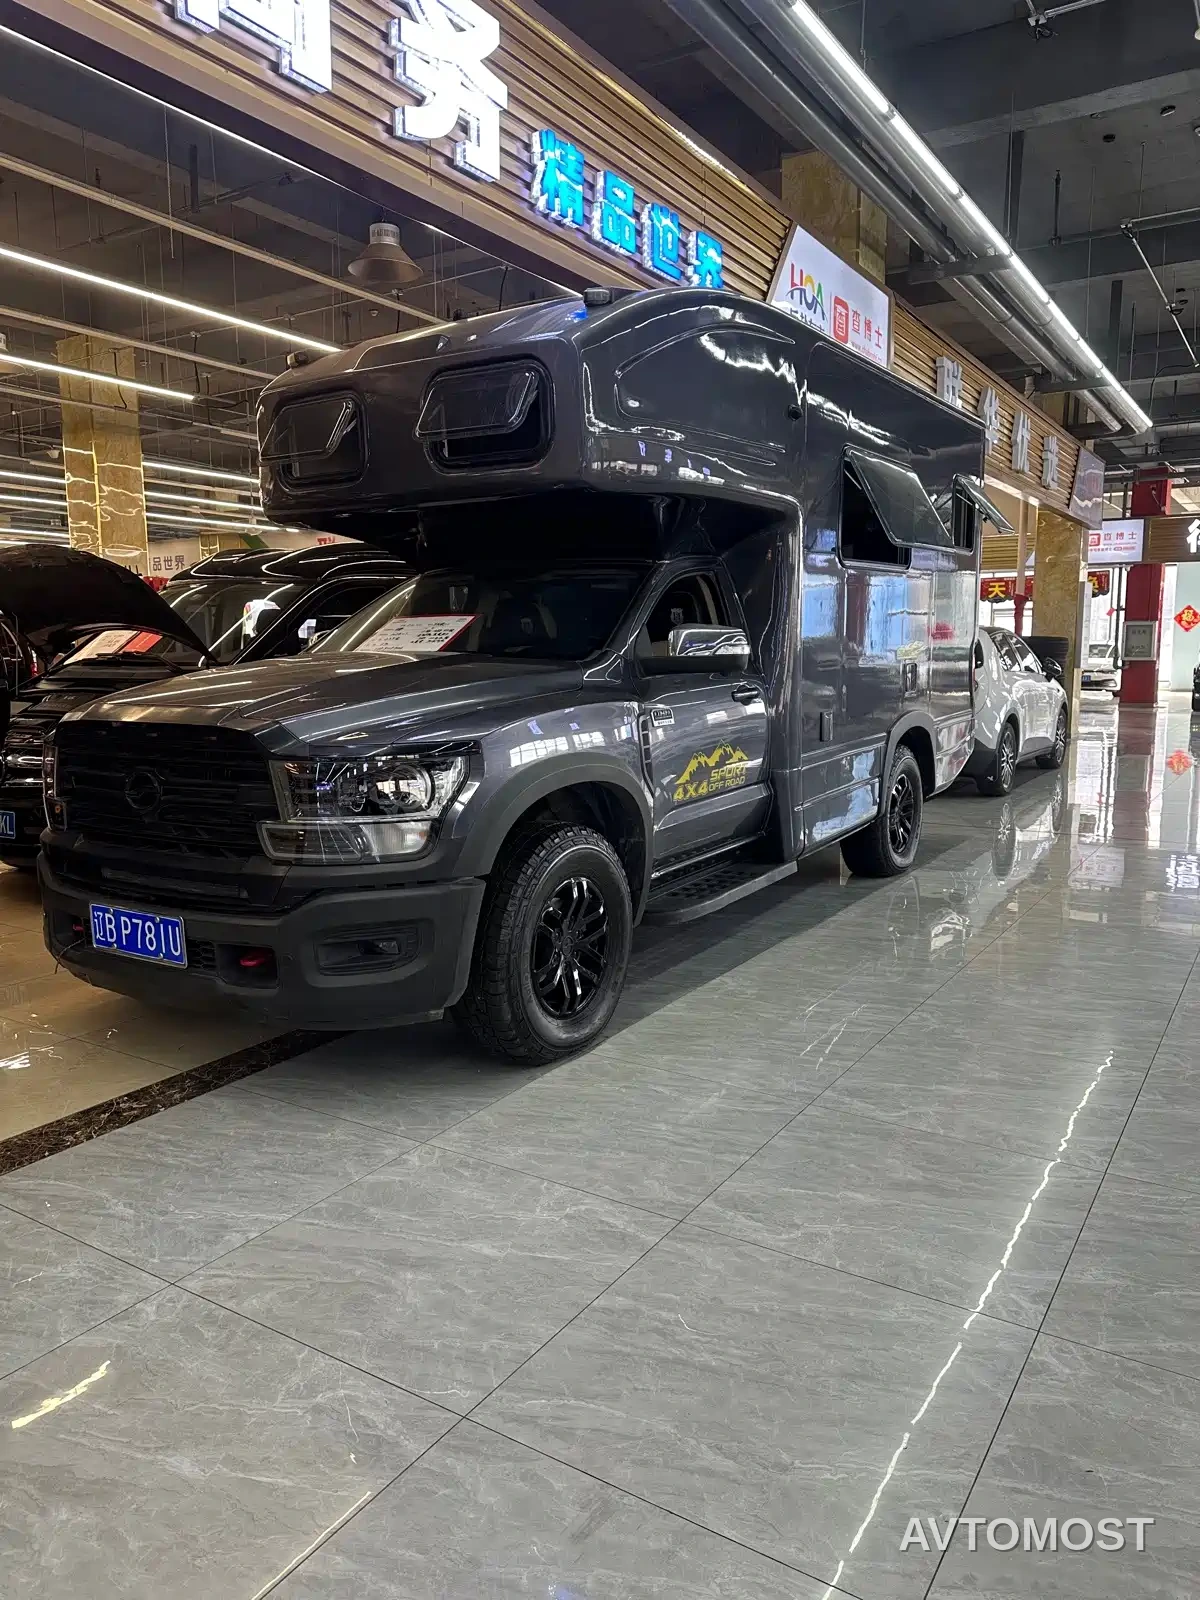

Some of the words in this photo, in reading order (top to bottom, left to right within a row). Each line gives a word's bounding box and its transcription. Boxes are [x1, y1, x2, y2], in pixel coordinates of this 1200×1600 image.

[533, 128, 724, 289] 精品世界
[988, 581, 1006, 599] 天
[709, 763, 748, 782] SPORT
[672, 780, 709, 801] 4X4
[708, 782, 725, 792] OFF
[724, 775, 746, 788] ROAD
